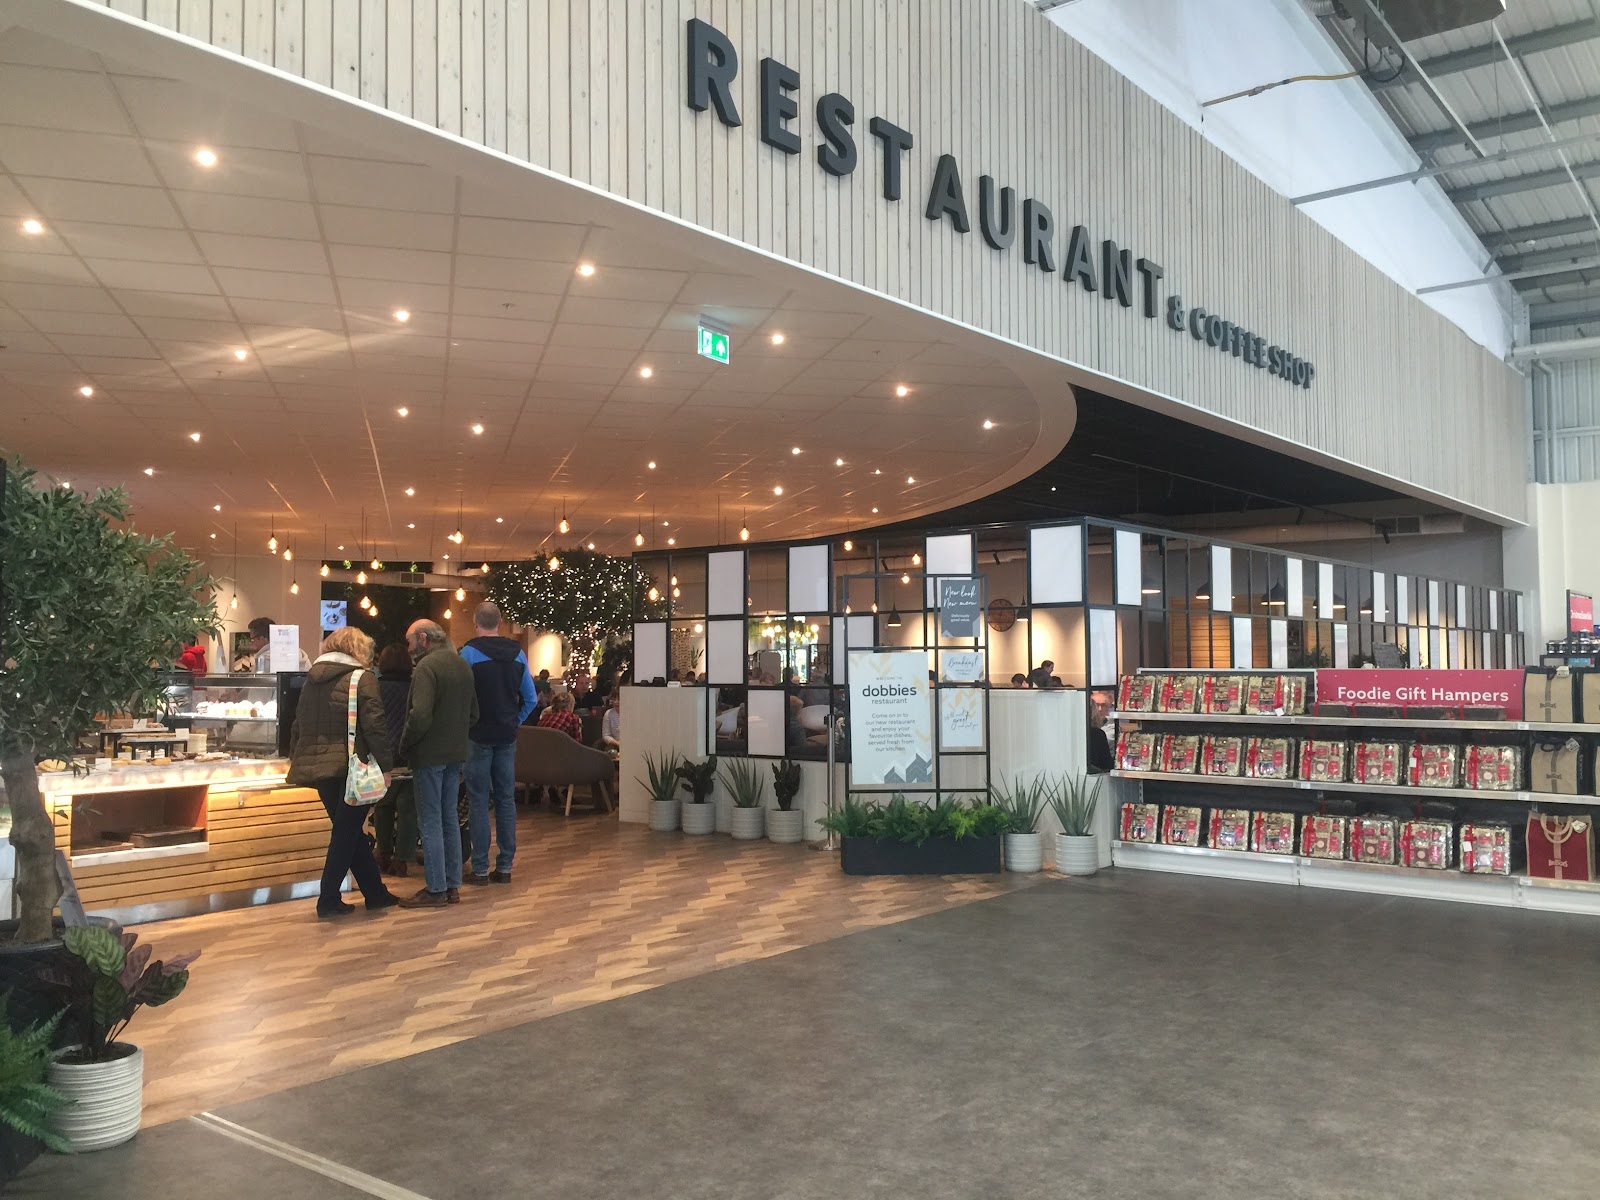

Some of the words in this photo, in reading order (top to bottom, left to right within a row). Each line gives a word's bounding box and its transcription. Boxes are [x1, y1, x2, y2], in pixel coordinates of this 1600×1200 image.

[687, 18, 1163, 318] RESTAURANT
[1168, 295, 1185, 331] &
[1190, 307, 1267, 368] COFFEE
[1268, 346, 1315, 389] SHOP
[862, 684, 917, 697] dobbies
[1338, 686, 1391, 700] Foodie
[1396, 687, 1426, 701] Gift
[1432, 688, 1508, 703] Hampers
